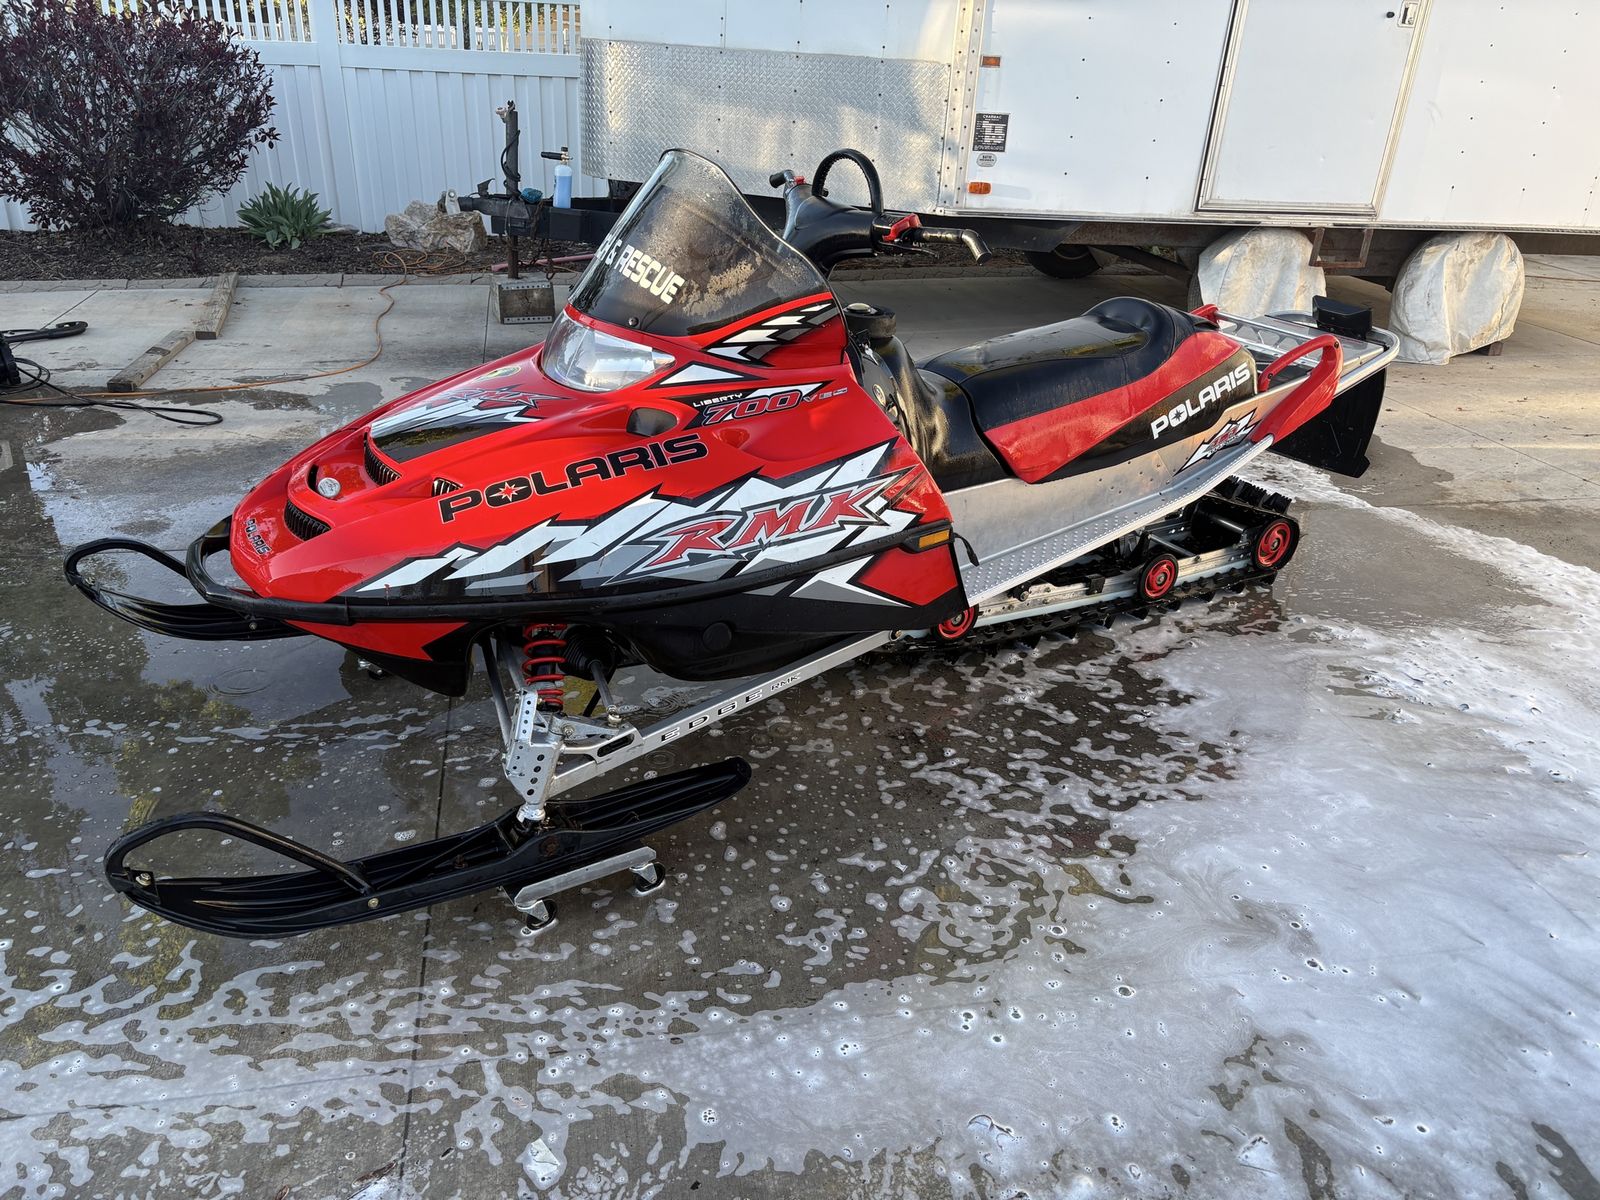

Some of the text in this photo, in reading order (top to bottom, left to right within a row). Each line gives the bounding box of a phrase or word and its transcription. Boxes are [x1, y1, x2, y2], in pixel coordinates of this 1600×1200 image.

[614, 244, 685, 304] RESCUE
[693, 392, 743, 407] LIBERTY
[702, 390, 801, 426] 700
[1150, 362, 1251, 440] POLARIS
[438, 432, 710, 524] POLARIS
[638, 477, 892, 572] RMK
[661, 672, 801, 742] EDGE RMK
